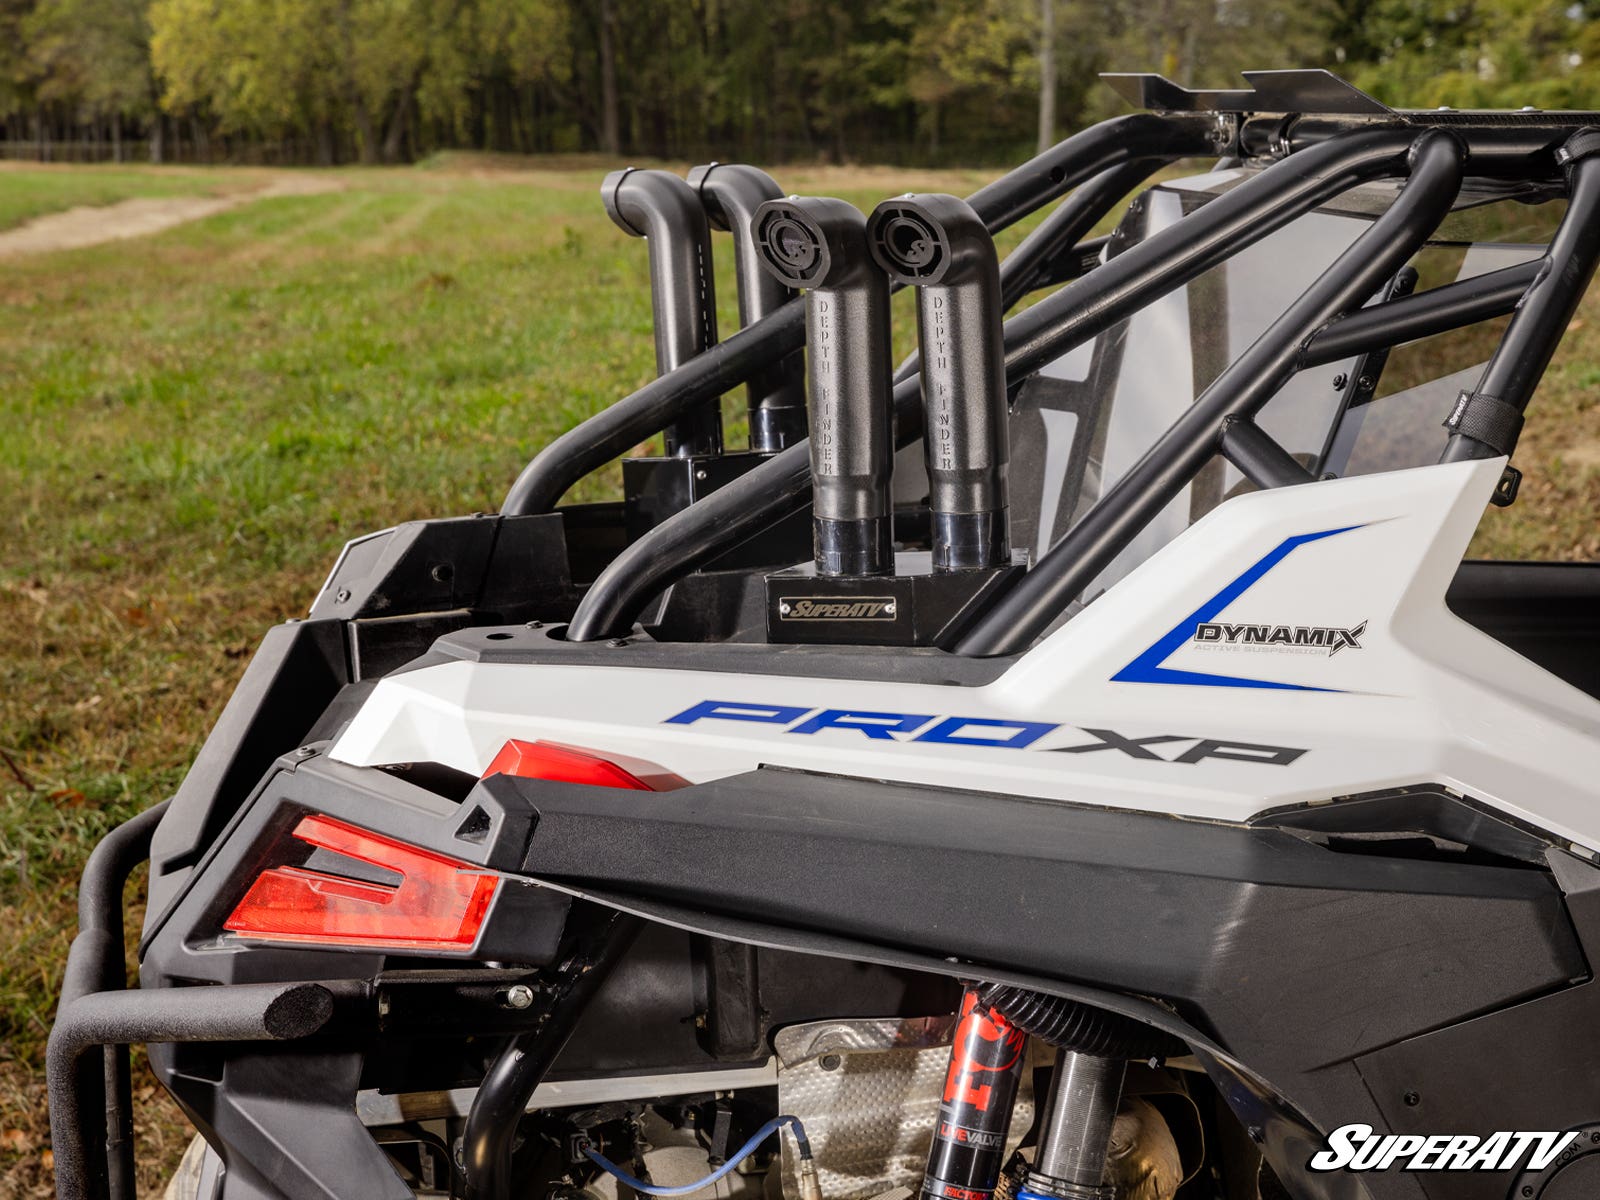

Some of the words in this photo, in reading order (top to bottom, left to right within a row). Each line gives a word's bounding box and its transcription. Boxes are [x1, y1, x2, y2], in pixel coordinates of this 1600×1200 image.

[819, 300, 831, 374] DEPTH
[933, 296, 947, 369] DEPTH
[821, 390, 833, 475] FINDER
[938, 384, 952, 469] FINDER
[789, 600, 886, 618] SUPERATV
[1194, 619, 1369, 657] DYNAMIX
[1194, 643, 1240, 653] ACTIVE
[1243, 645, 1328, 656] SUSPENSION
